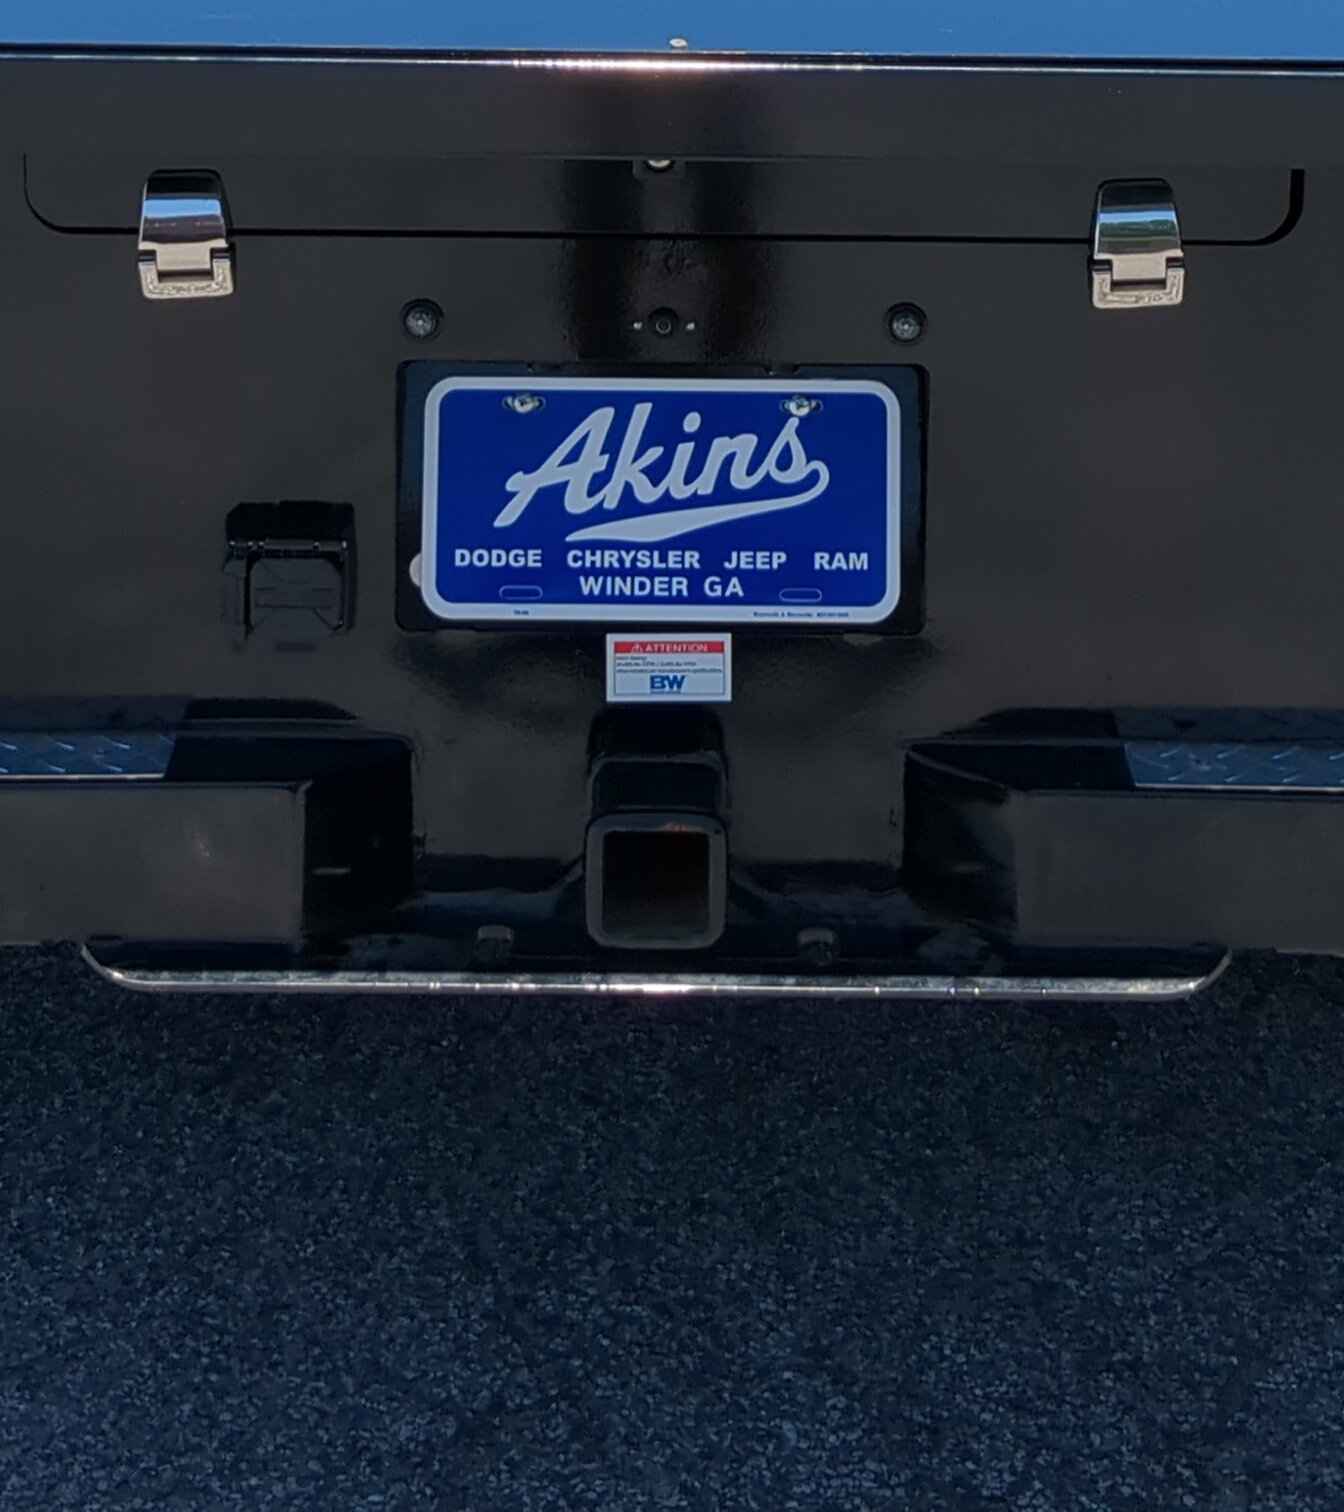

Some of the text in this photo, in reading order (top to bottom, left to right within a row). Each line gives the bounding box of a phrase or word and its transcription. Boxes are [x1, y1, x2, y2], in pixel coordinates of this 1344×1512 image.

[493, 401, 830, 542] Akins
[454, 548, 869, 571] DODGE CHRYSLER JEEP RAM
[579, 575, 744, 598] WINDER GA
[645, 643, 709, 653] ATTENTION
